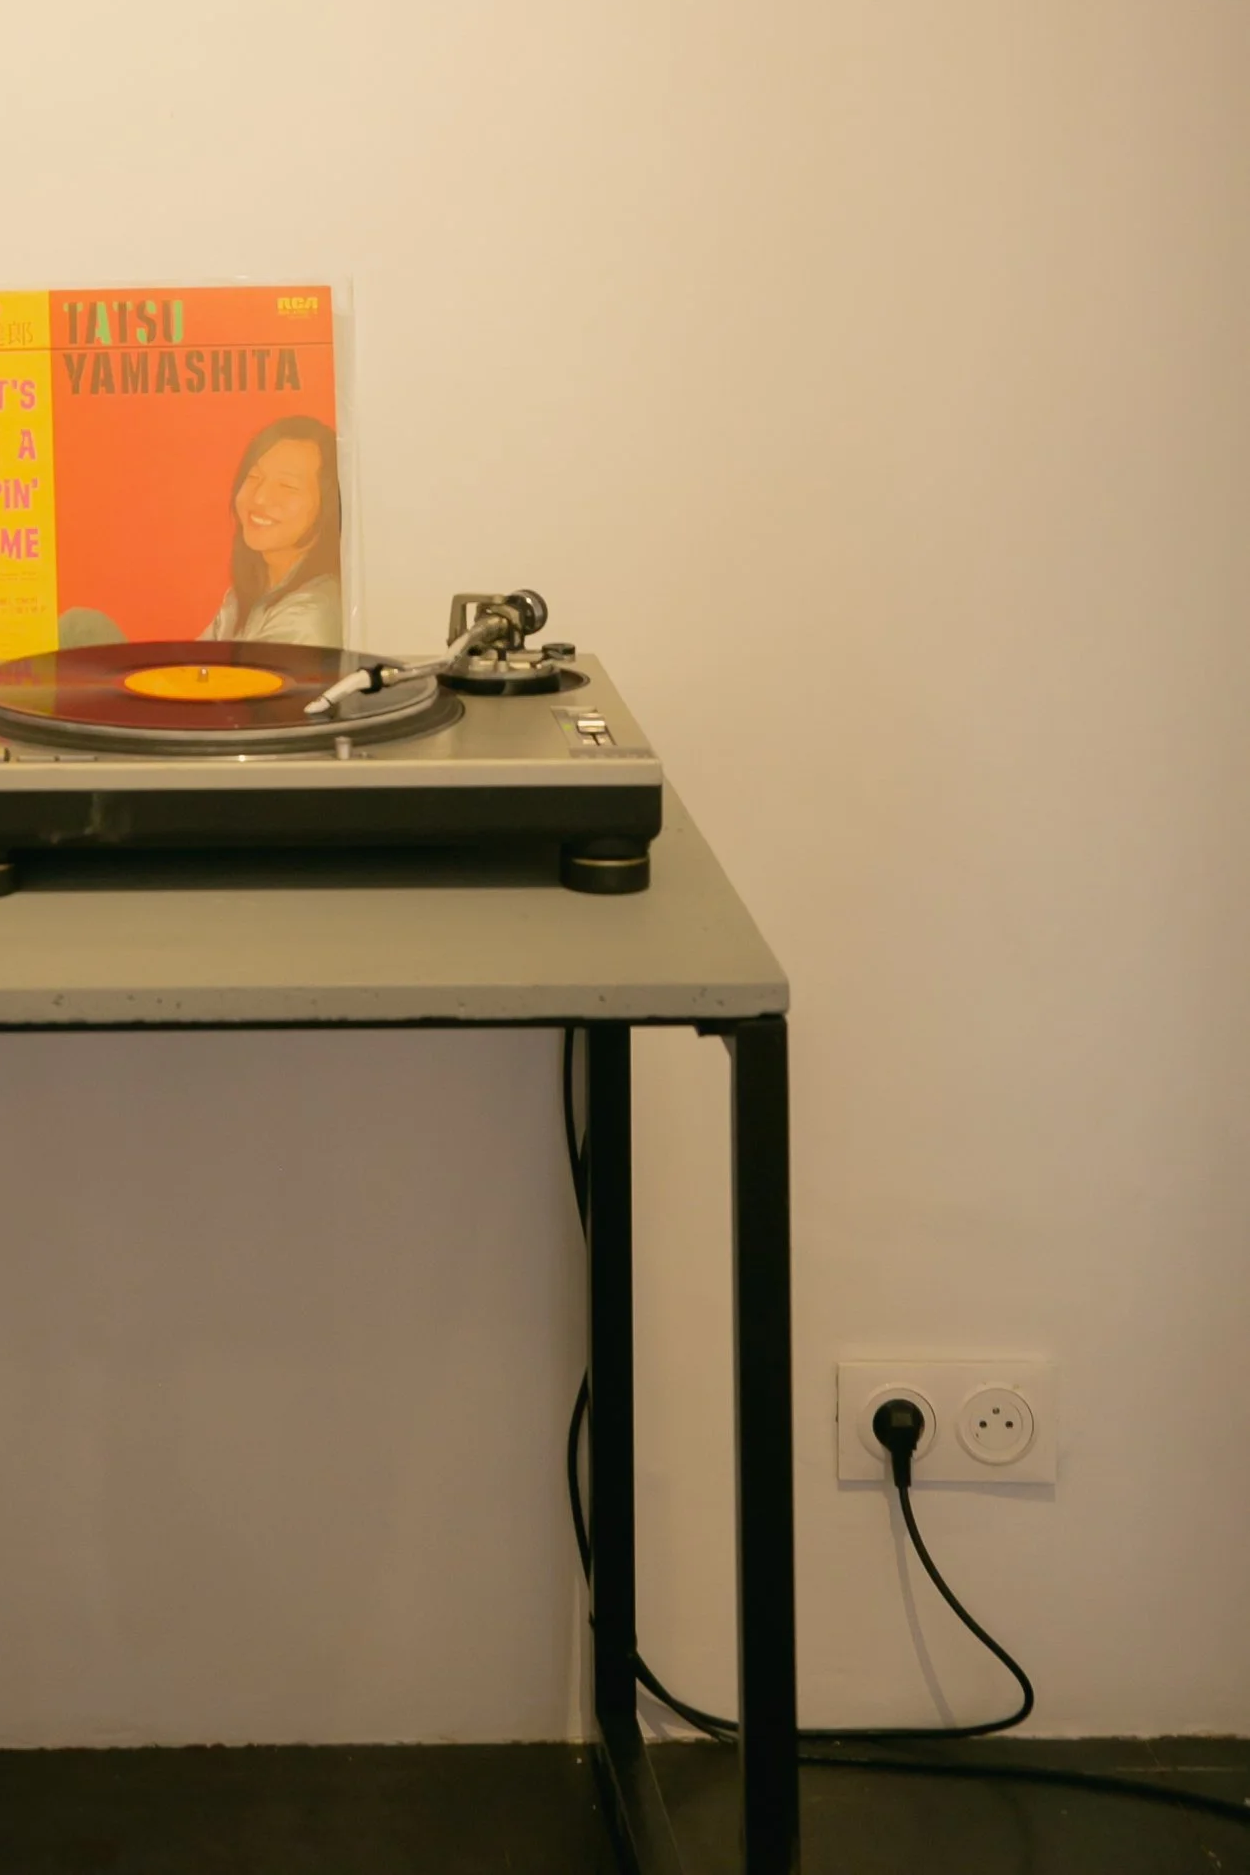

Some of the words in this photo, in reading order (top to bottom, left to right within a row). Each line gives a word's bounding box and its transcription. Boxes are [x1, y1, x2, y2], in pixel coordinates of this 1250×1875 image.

[63, 300, 184, 345] TATSU
[277, 297, 318, 310] RCA
[63, 348, 302, 395] YAMASHITA
[18, 428, 36, 460] A
